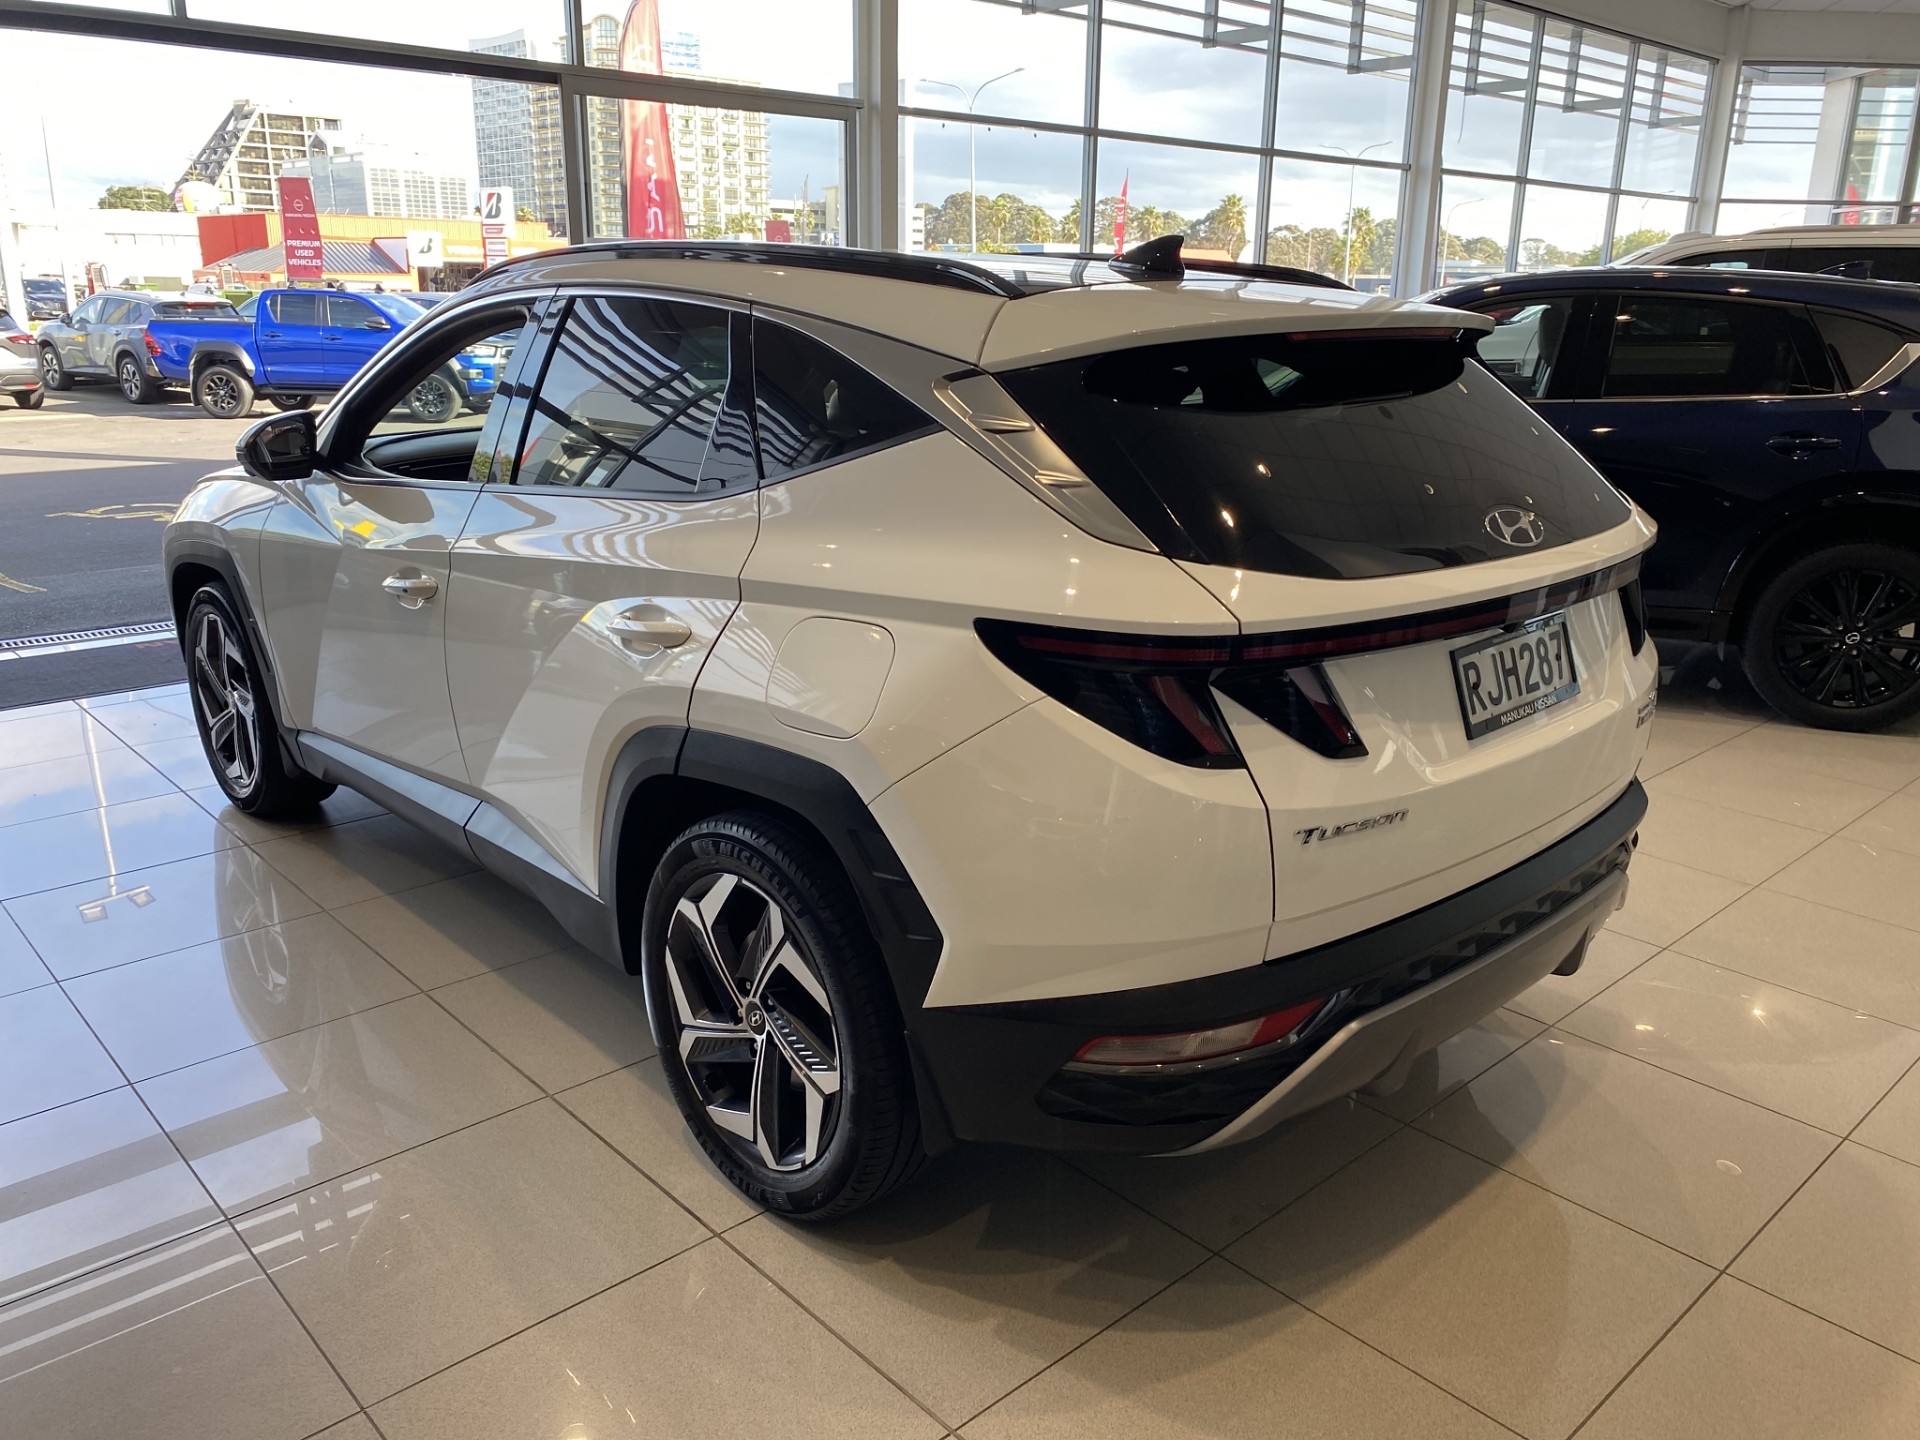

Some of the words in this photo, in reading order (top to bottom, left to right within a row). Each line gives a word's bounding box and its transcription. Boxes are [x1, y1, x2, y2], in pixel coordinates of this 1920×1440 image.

[286, 239, 321, 248] PREMIUM
[294, 249, 315, 257] USED
[287, 258, 322, 266] VEHICLES
[1462, 630, 1564, 715] RJH287
[1500, 703, 1535, 725] MANUKAU
[1534, 694, 1557, 712] NISSAN
[718, 841, 802, 913] MICHELIN
